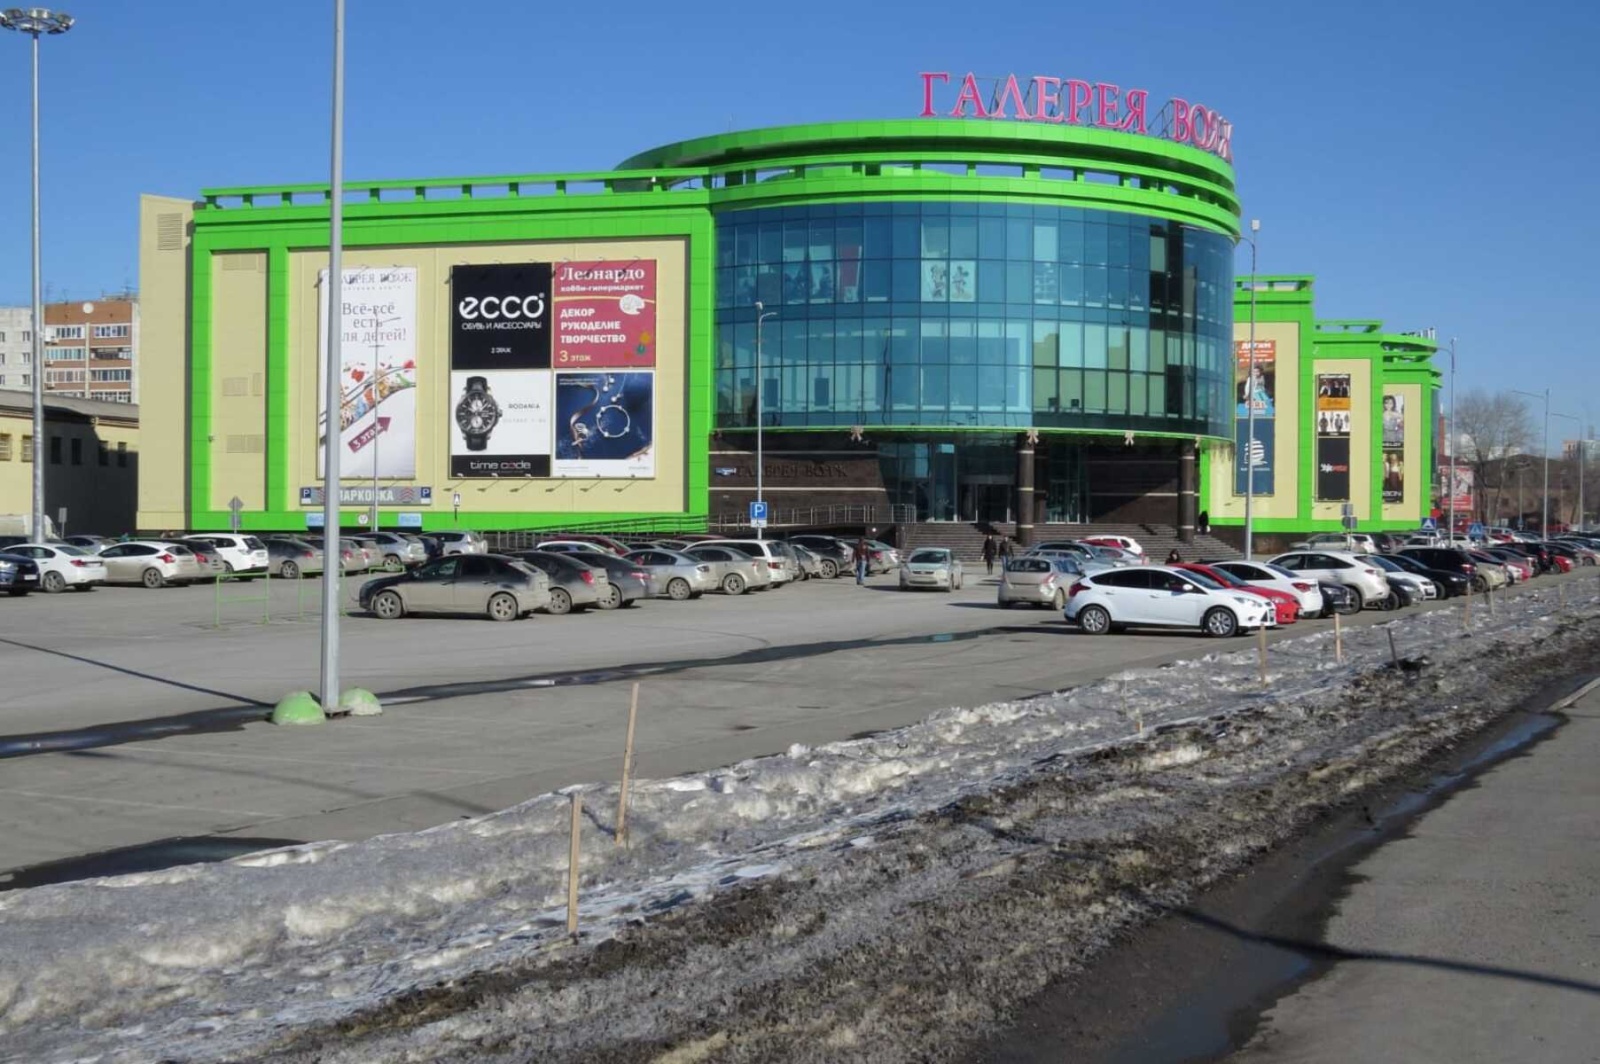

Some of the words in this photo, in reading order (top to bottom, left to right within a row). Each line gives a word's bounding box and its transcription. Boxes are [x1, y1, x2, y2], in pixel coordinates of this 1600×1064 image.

[919, 71, 1149, 134] ГАЛЕРЕЯ
[560, 267, 645, 283] Леонардо
[560, 308, 596, 319] ДЕКОР
[461, 322, 485, 330] ОБУВЬ
[486, 322, 493, 330] И
[493, 321, 542, 330] АКСЕССУАРЫ
[560, 321, 622, 331] РУКОДЕЛИЕ
[341, 331, 358, 342] ля
[362, 327, 407, 344] детей!
[560, 334, 627, 344] ТВОРЧЕСТВО
[559, 350, 569, 362] 3
[352, 438, 361, 449] 3
[470, 461, 499, 470] time
[500, 460, 532, 470] code
